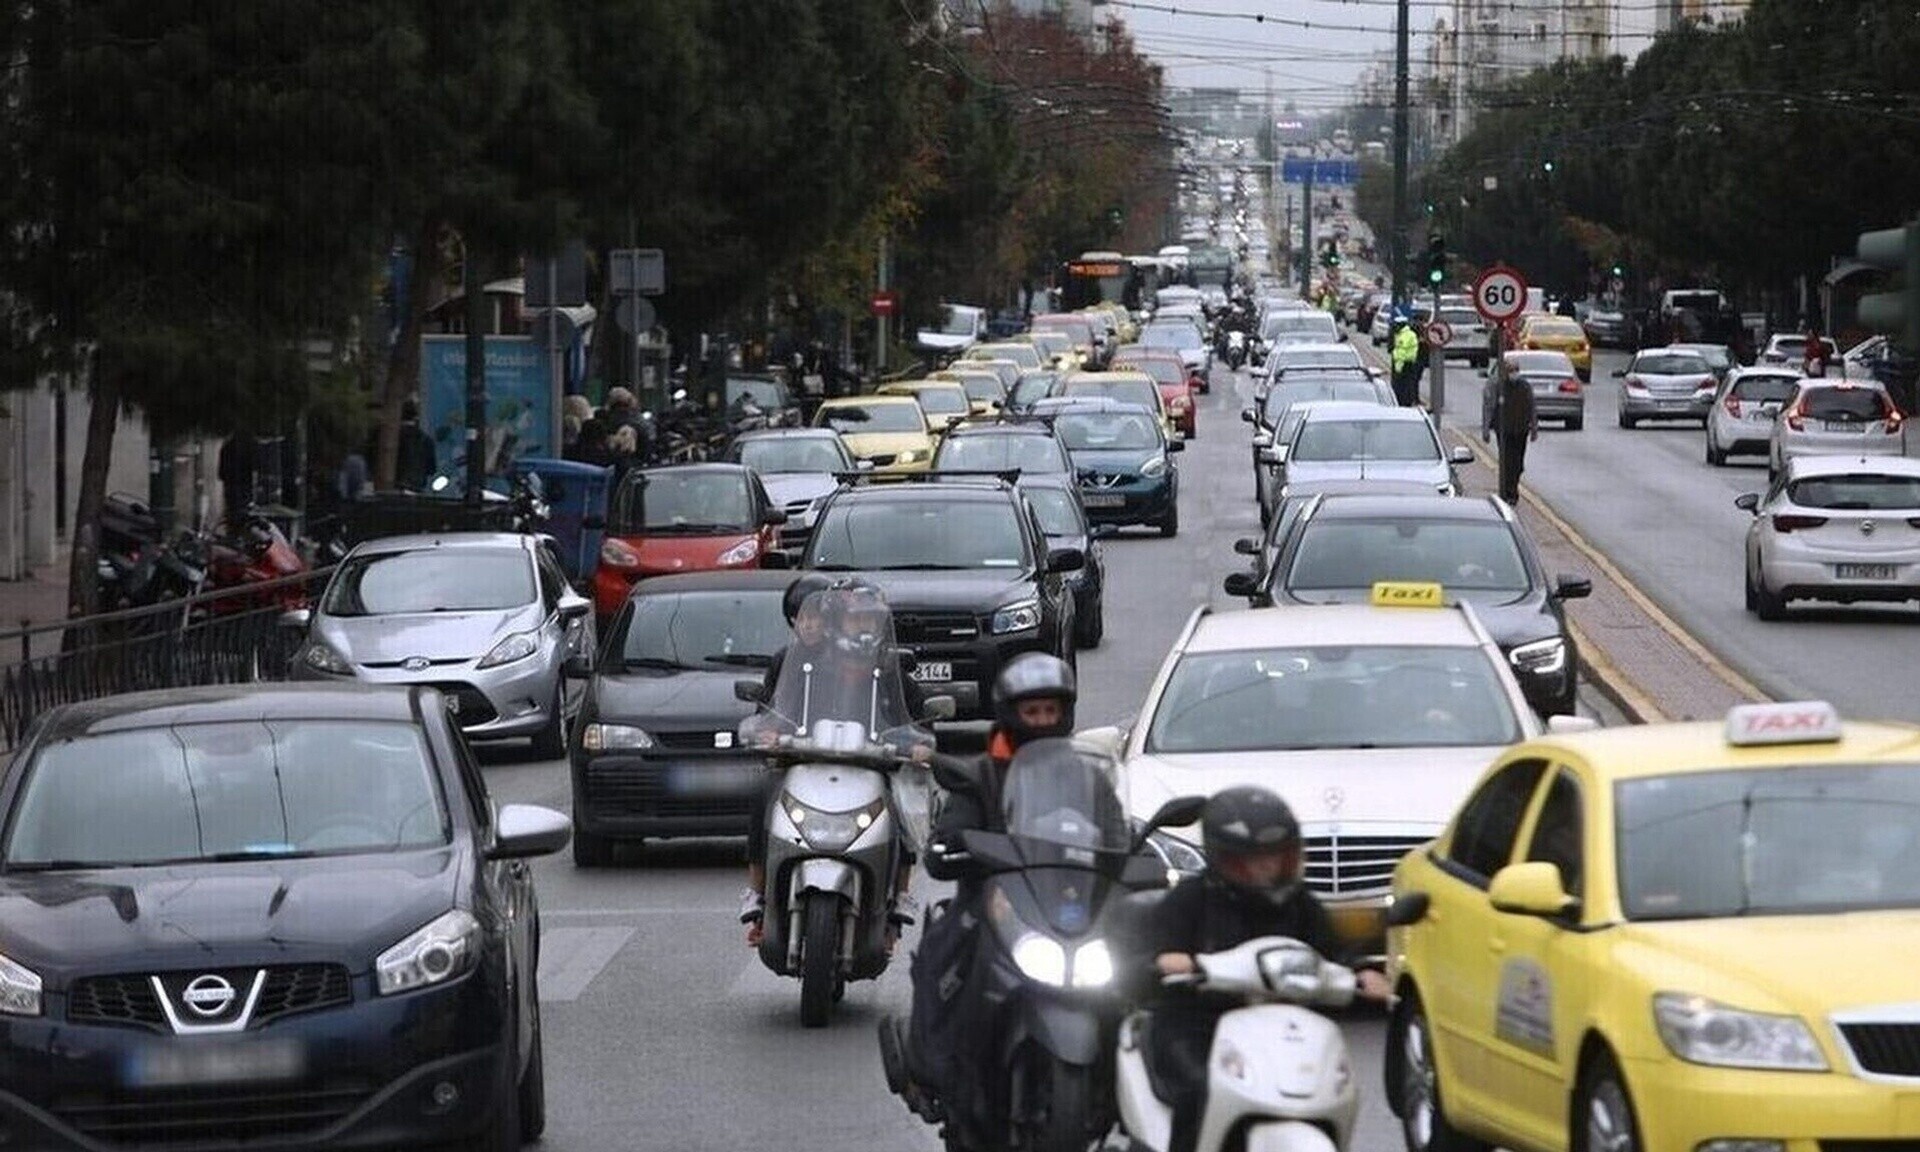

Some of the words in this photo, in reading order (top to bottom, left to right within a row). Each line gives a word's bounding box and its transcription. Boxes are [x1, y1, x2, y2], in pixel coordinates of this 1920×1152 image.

[1485, 285, 1515, 306] 60
[1378, 586, 1435, 600] Taxi
[1745, 712, 1827, 731] TAXI
